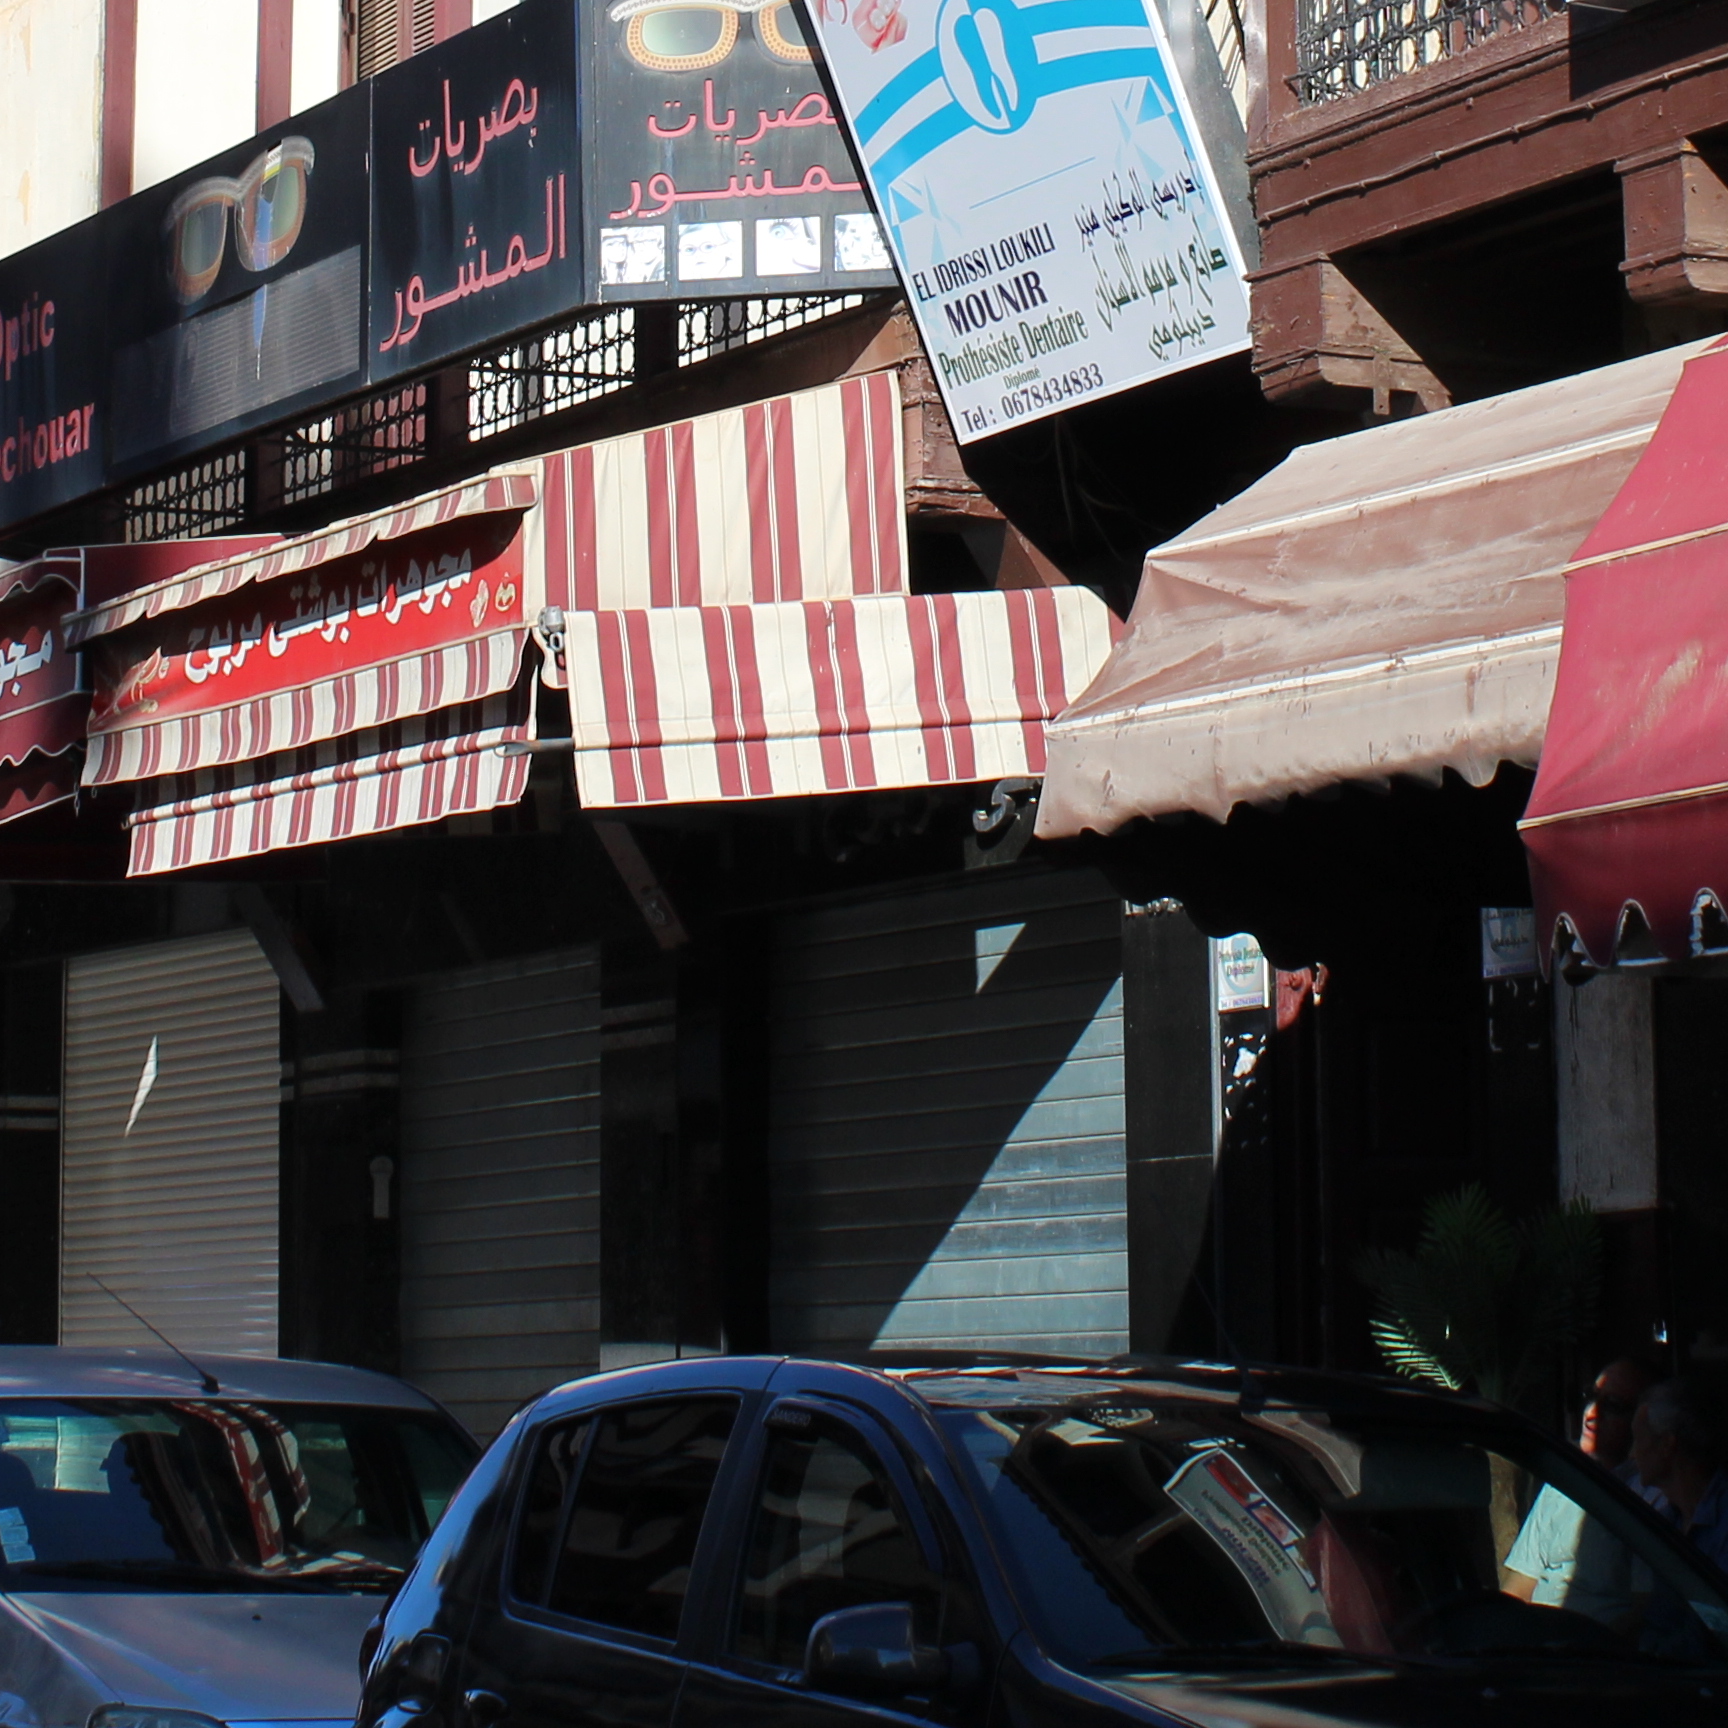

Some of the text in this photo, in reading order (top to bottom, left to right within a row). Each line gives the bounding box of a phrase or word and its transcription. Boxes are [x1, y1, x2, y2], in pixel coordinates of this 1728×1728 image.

[409, 77, 539, 178] بصريات
[1074, 204, 1101, 253] منير
[1102, 167, 1150, 239] الوكيلي
[379, 172, 566, 353] المشور
[912, 222, 1056, 302] EL IDRISSI LOUKILI
[1188, 210, 1228, 307] صانع
[943, 270, 1049, 339] MOUNIR
[1149, 298, 1217, 362] ديبلومي
[938, 306, 1090, 390] Prothésiste Dentaire
[1002, 364, 1042, 390] Diplomé
[1000, 362, 1104, 420] 0678434833
[356, 548, 473, 624] مجوهرات
